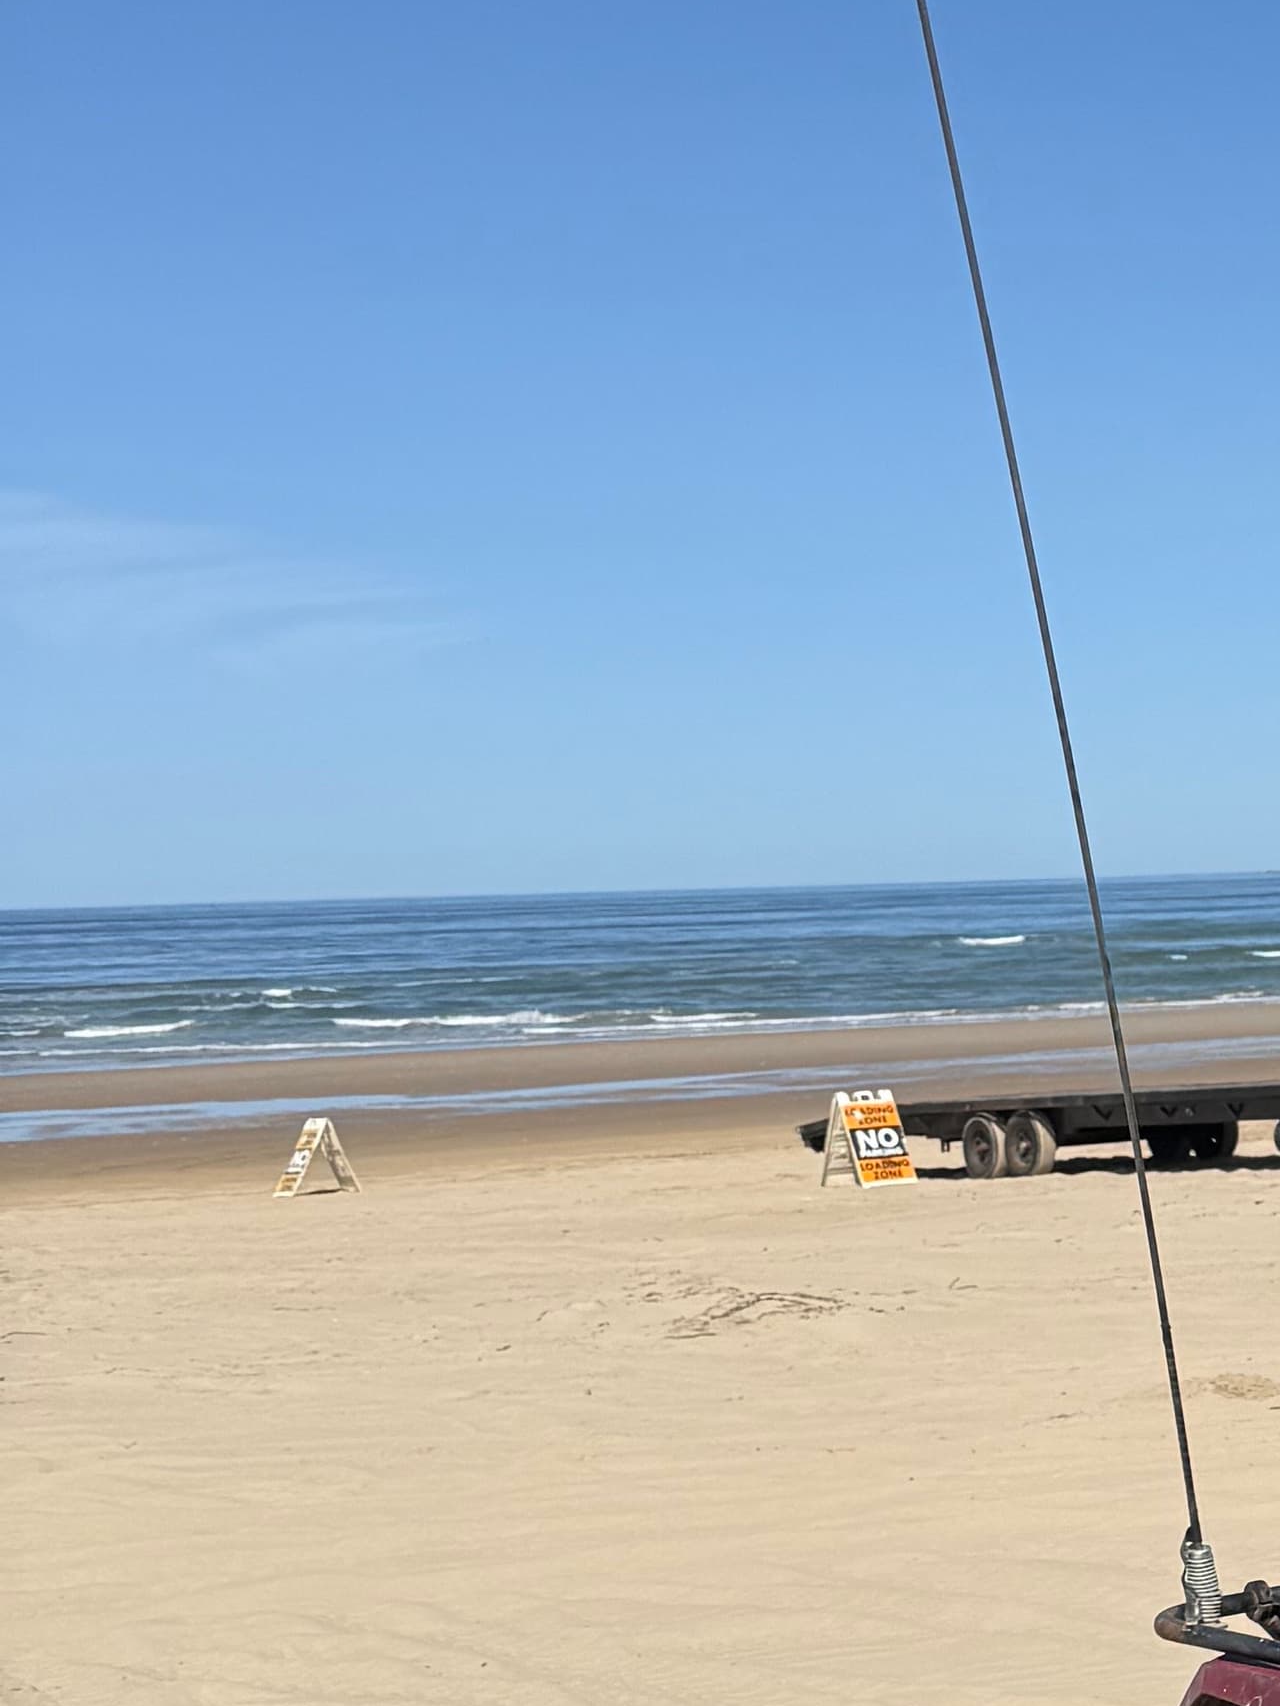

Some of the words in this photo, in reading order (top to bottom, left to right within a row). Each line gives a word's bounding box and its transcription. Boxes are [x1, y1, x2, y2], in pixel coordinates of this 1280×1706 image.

[854, 1128, 899, 1151] NO
[860, 1158, 910, 1173] LOADING
[873, 1168, 904, 1181] ZONE
